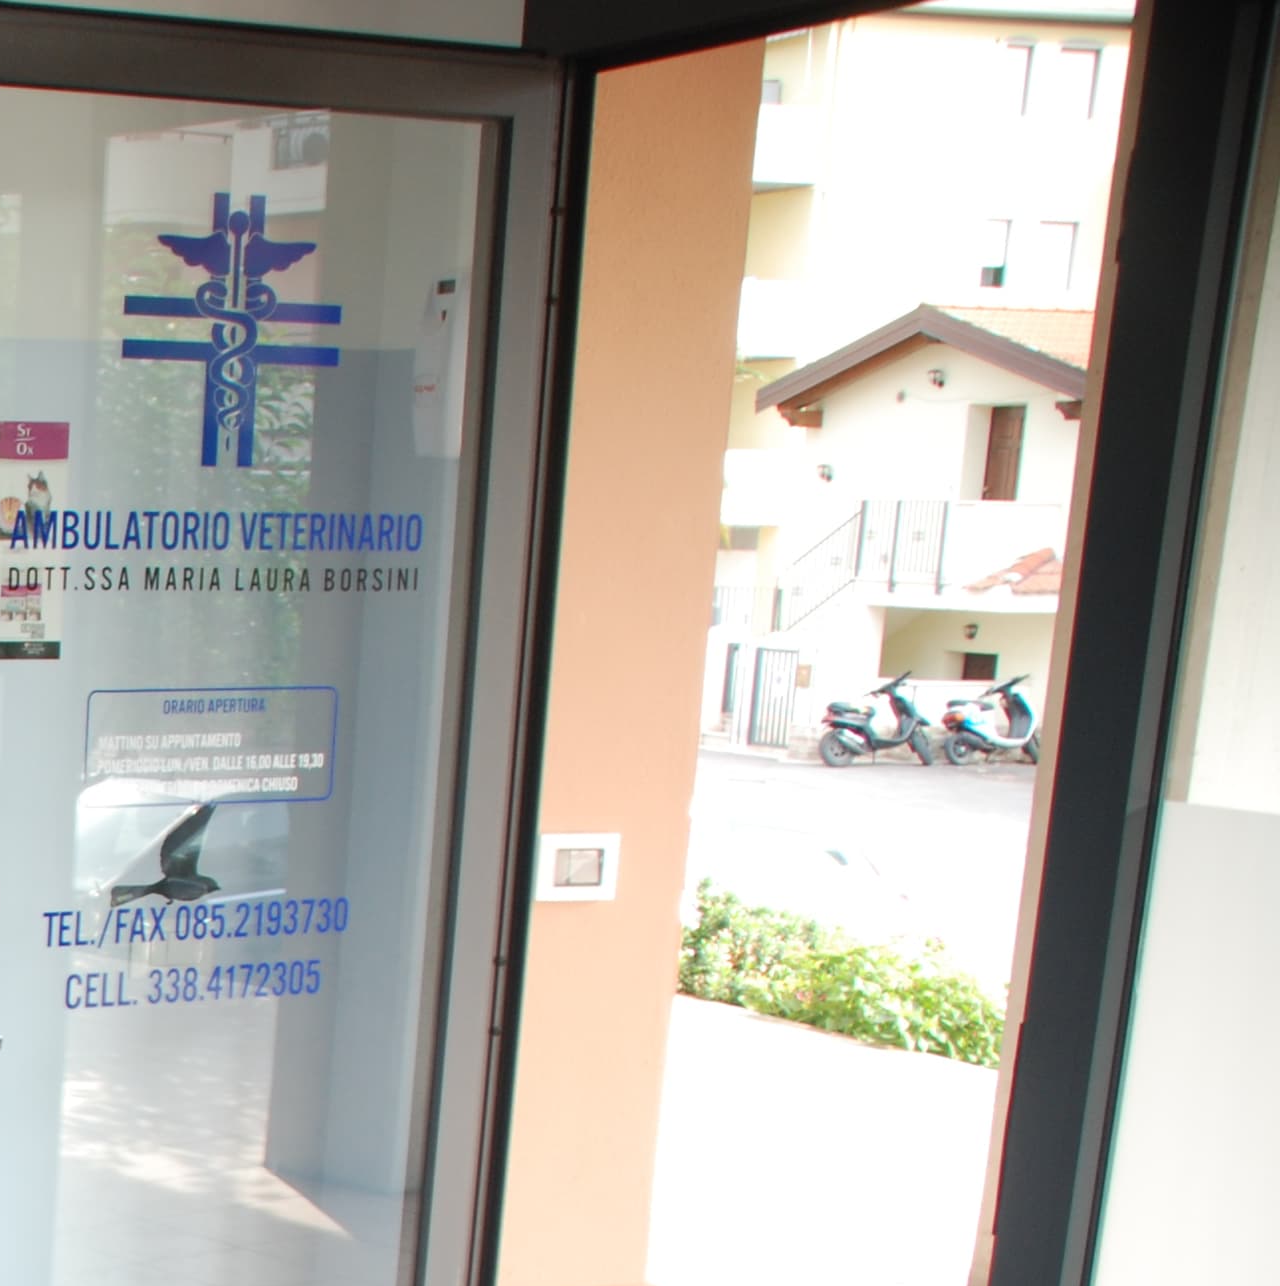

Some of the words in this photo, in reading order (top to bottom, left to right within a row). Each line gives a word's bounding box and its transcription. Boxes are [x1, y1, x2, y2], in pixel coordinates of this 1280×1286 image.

[10, 510, 230, 550] AMBULATORIO
[240, 512, 423, 552] VETERINARIO
[8, 566, 130, 592] DOTT.SSA
[144, 567, 221, 592] MARIA
[234, 567, 311, 592] LAURA
[324, 567, 419, 592] BORSINI
[163, 699, 205, 715] ORARIO
[208, 697, 266, 713] APERTURA
[145, 735, 159, 750] SU
[161, 732, 241, 750] APPUNTAMENTO
[212, 754, 243, 771] DALLE
[273, 753, 297, 769] ALLE
[262, 776, 299, 793] CHIUSO
[43, 906, 168, 948] TEL./FAX
[175, 897, 349, 941] 085.2193730
[65, 971, 138, 1009] CELL.
[147, 960, 321, 1004] 338.4172305
